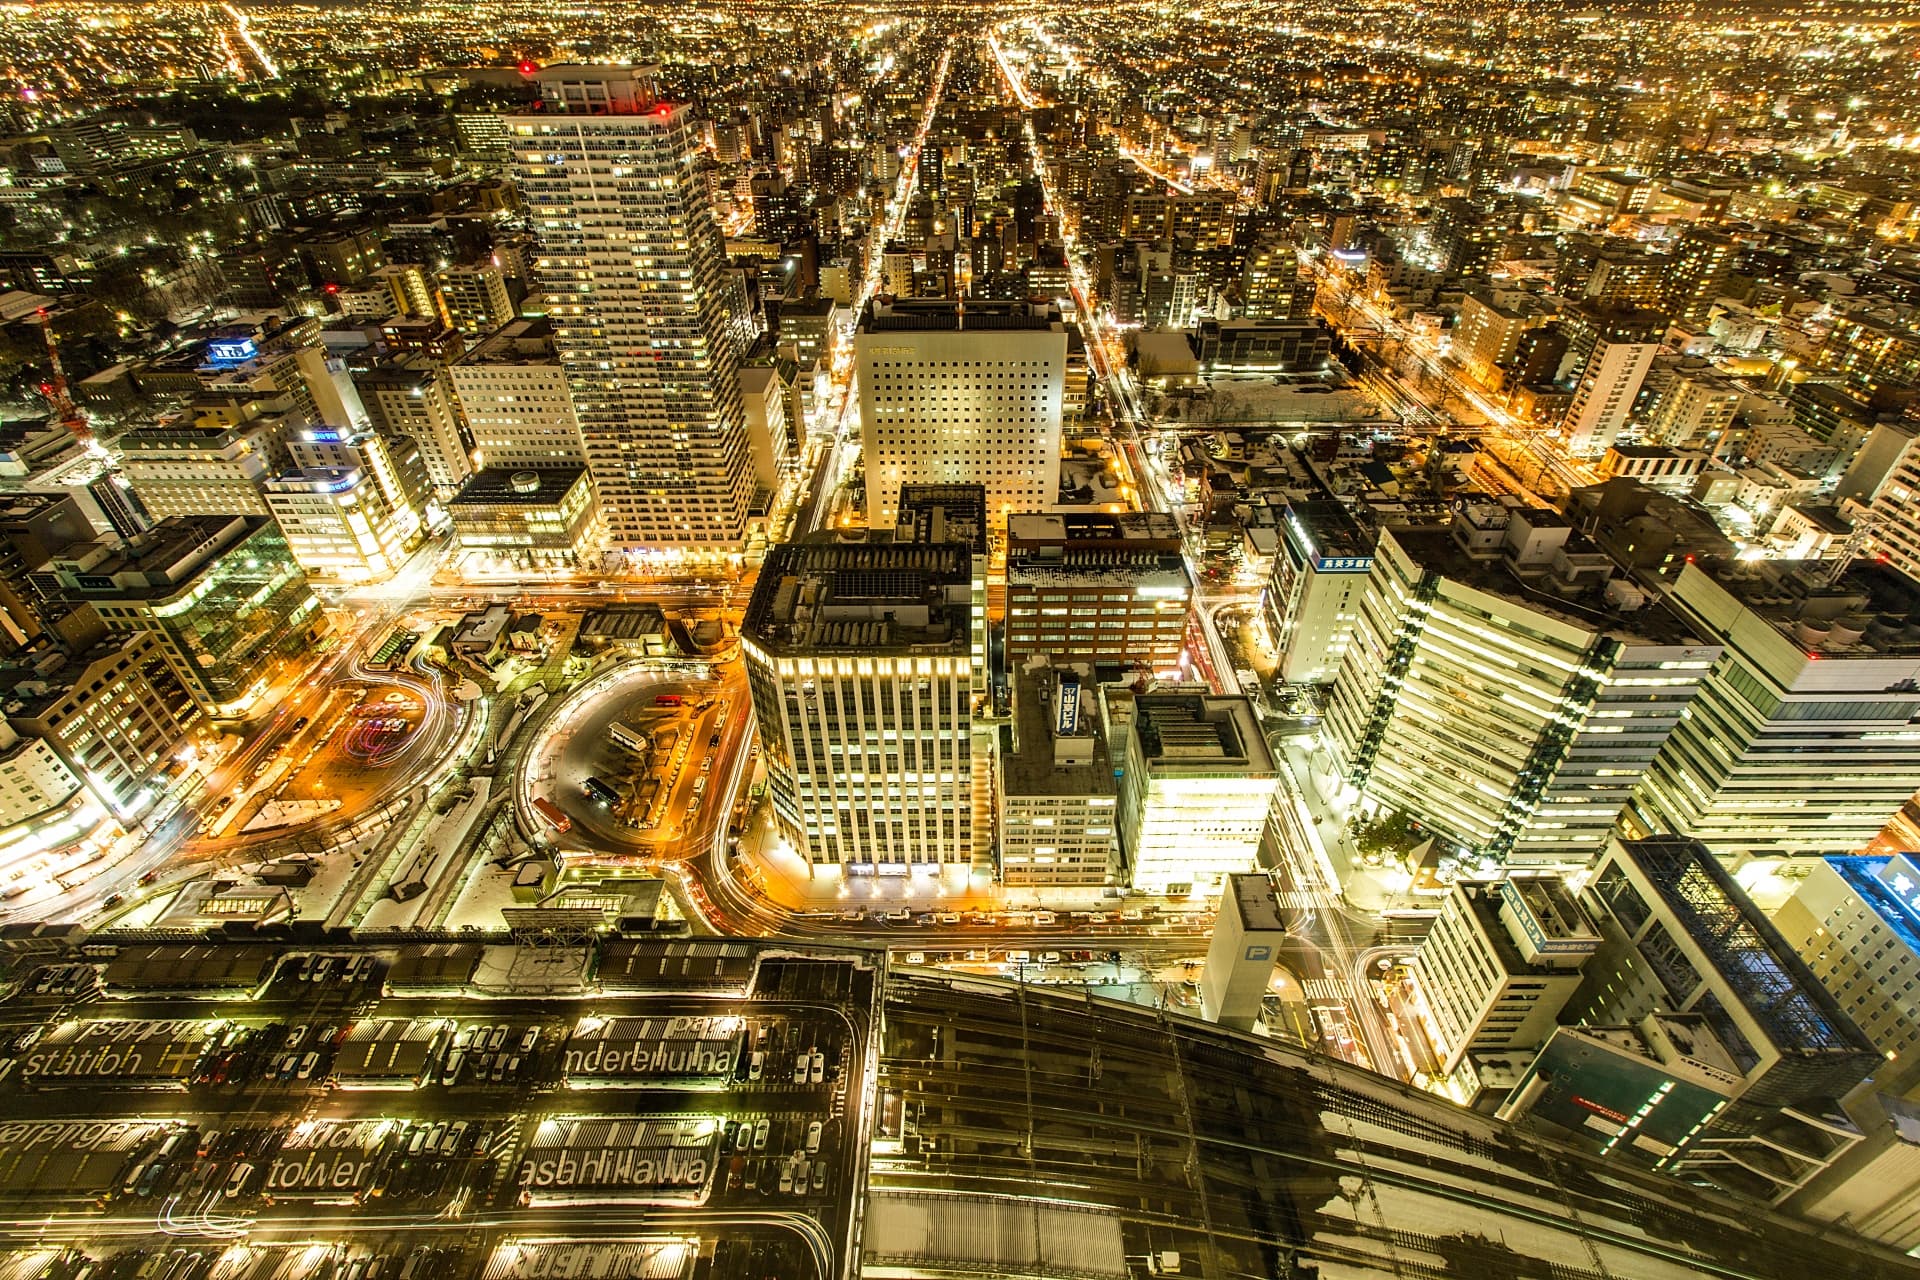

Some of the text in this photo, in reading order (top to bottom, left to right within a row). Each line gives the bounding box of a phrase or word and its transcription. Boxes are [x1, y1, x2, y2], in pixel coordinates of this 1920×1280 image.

[1249, 948, 1267, 959] P
[22, 1046, 142, 1076] station
[267, 1157, 371, 1188] tower
